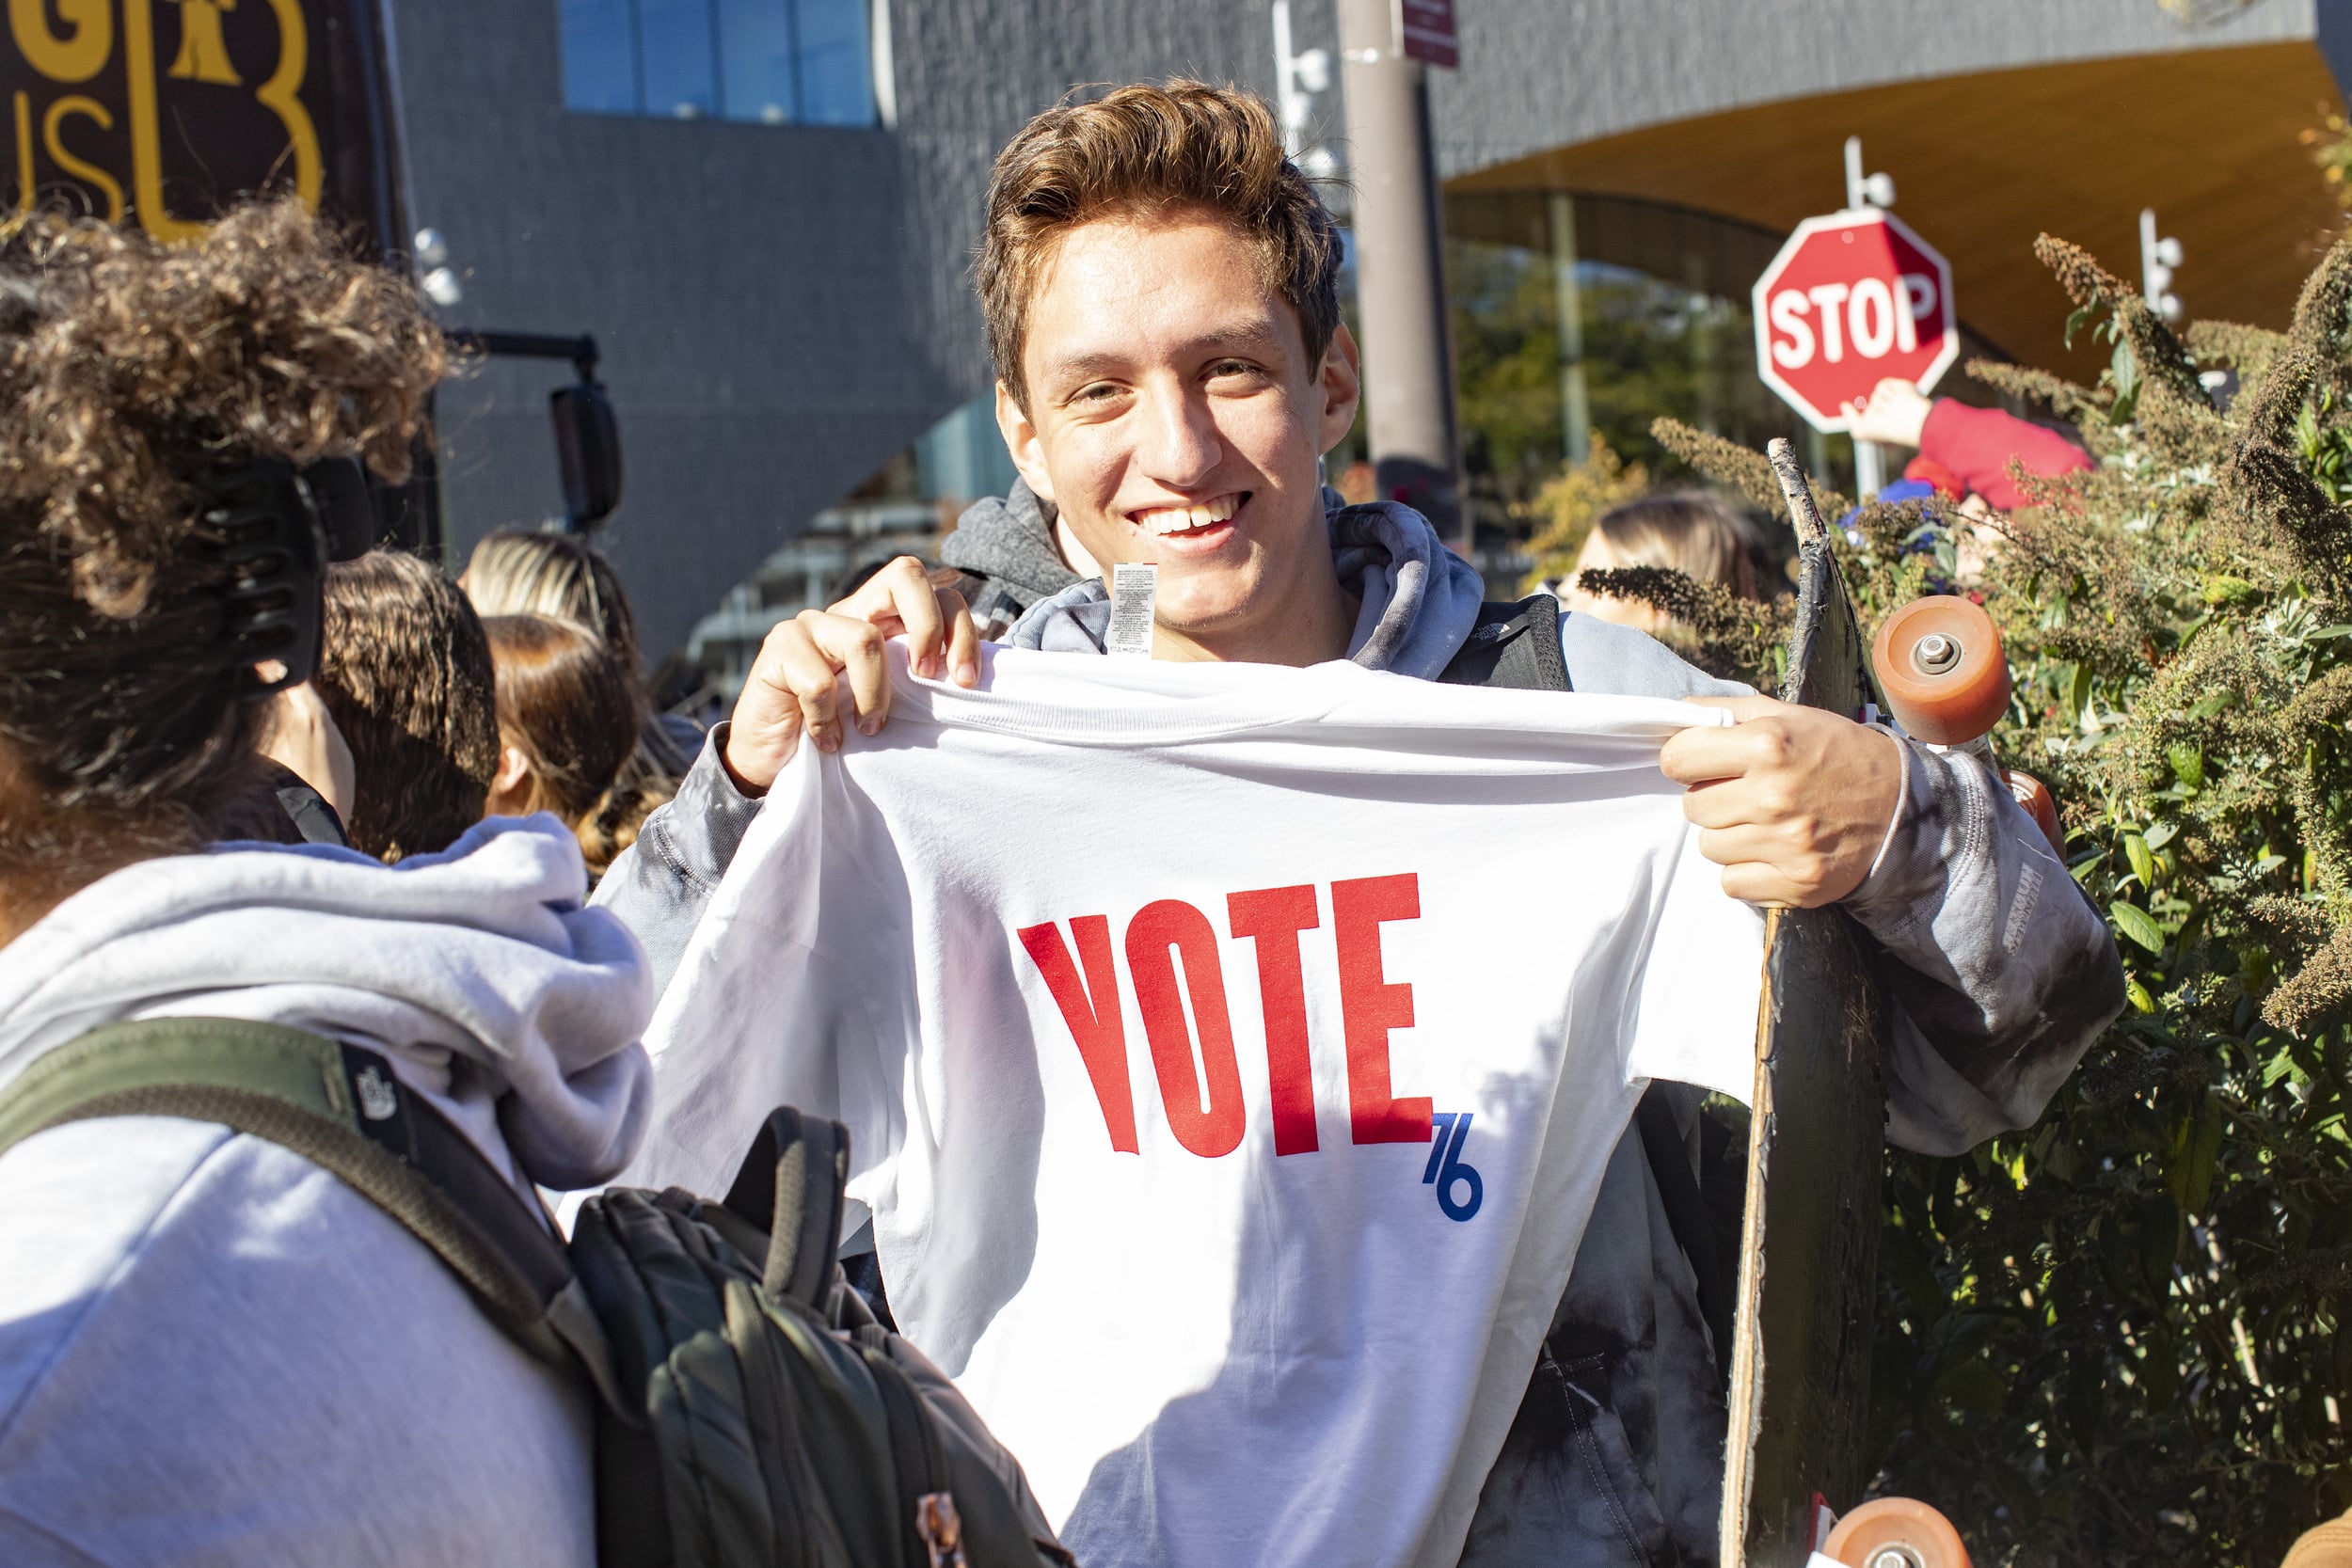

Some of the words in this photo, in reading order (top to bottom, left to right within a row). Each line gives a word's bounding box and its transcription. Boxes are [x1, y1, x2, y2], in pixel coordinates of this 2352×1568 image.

[1770, 273, 1937, 371] STOP
[1017, 872, 1433, 1158] VOTE
[1422, 1112, 1484, 1223] 76
